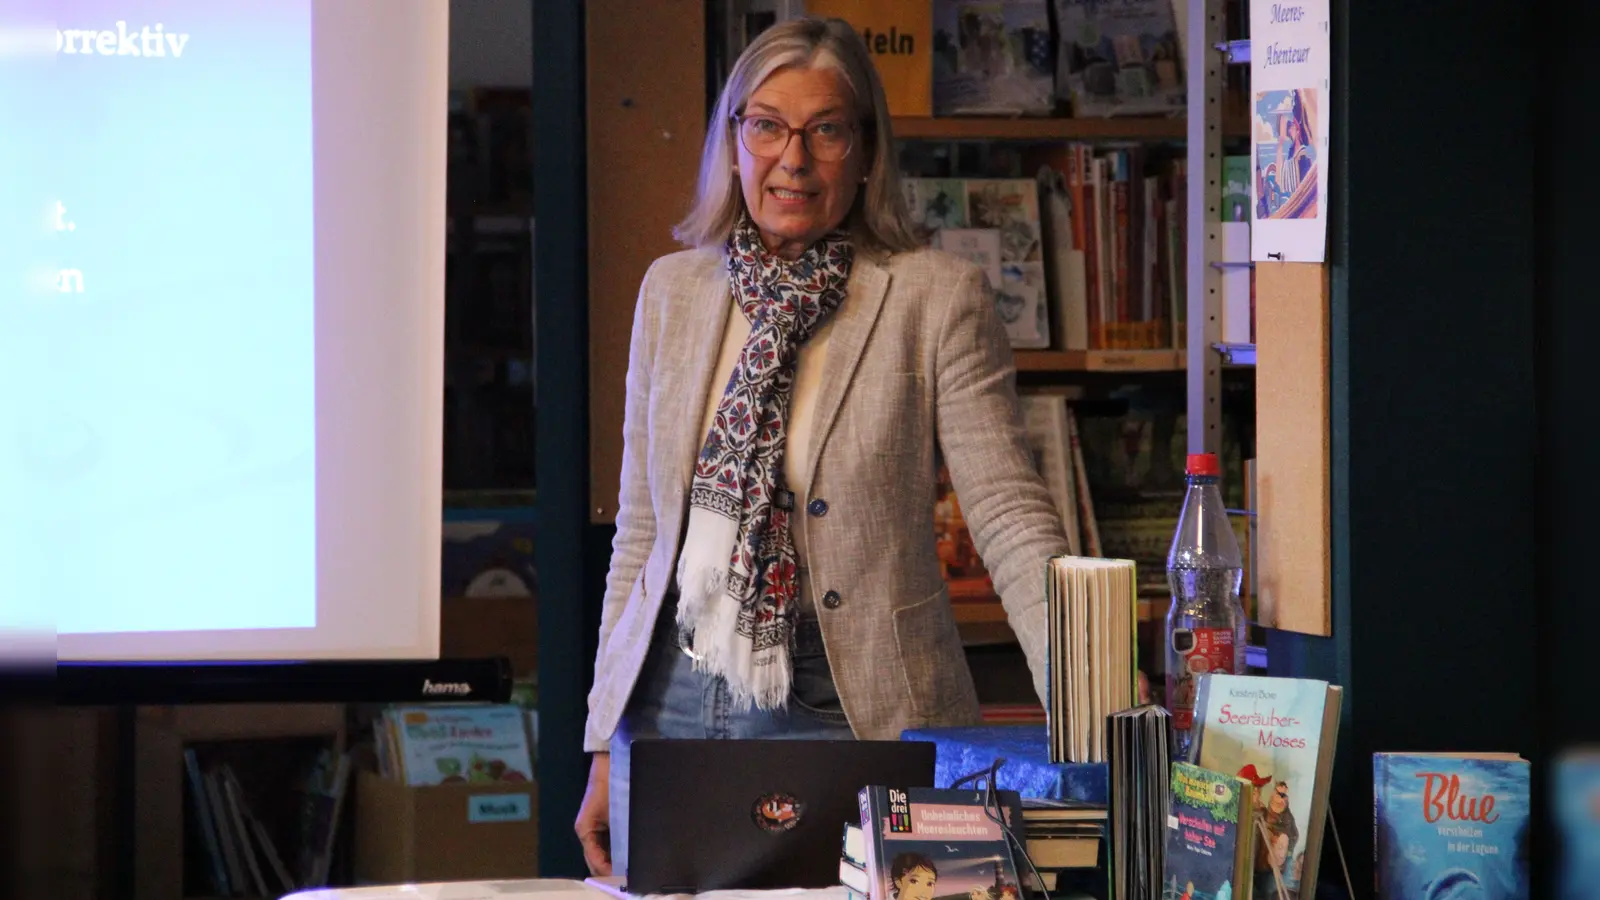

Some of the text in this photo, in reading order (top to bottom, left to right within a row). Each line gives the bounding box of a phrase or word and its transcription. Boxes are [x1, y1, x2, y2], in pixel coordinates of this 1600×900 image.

[1270, 4, 1304, 24] Meeres-
[1264, 42, 1311, 69] Abenteuer
[422, 679, 472, 695] hama
[1218, 703, 1301, 727] Seeräuber-
[1258, 729, 1307, 749] Moses
[889, 788, 907, 803] Die
[1416, 771, 1500, 824] Blue
[891, 802, 908, 814] drei
[921, 809, 981, 823] Unheimliches
[916, 821, 989, 837] Meeresleuchten
